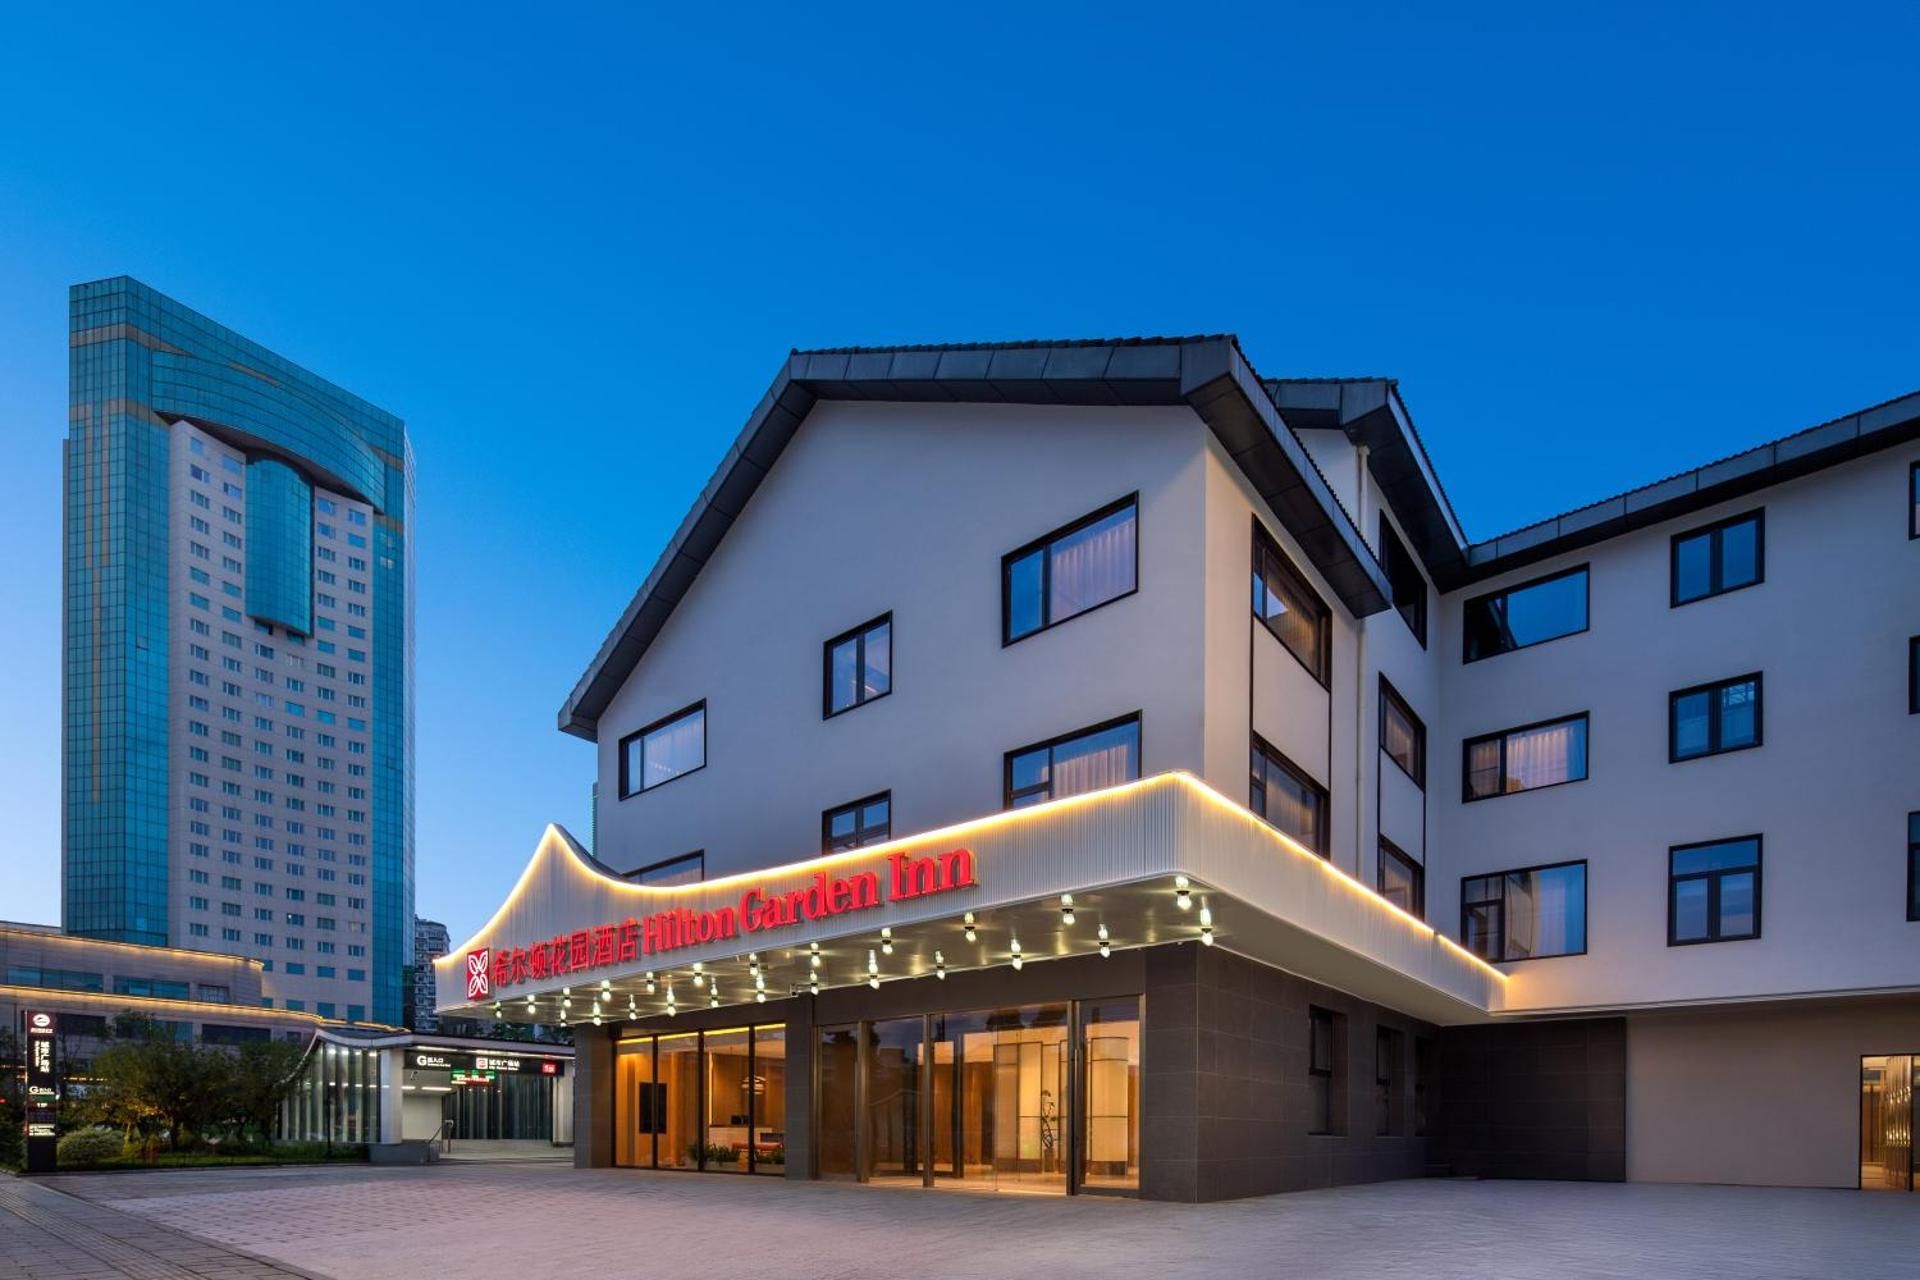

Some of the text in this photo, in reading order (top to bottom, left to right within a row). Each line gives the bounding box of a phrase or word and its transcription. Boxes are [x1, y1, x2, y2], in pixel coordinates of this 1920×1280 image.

[642, 847, 979, 955] Hilton Garden Inn
[490, 919, 642, 986] 希尔顿花园酒店
[417, 1056, 427, 1066] G
[29, 1086, 39, 1094] G
